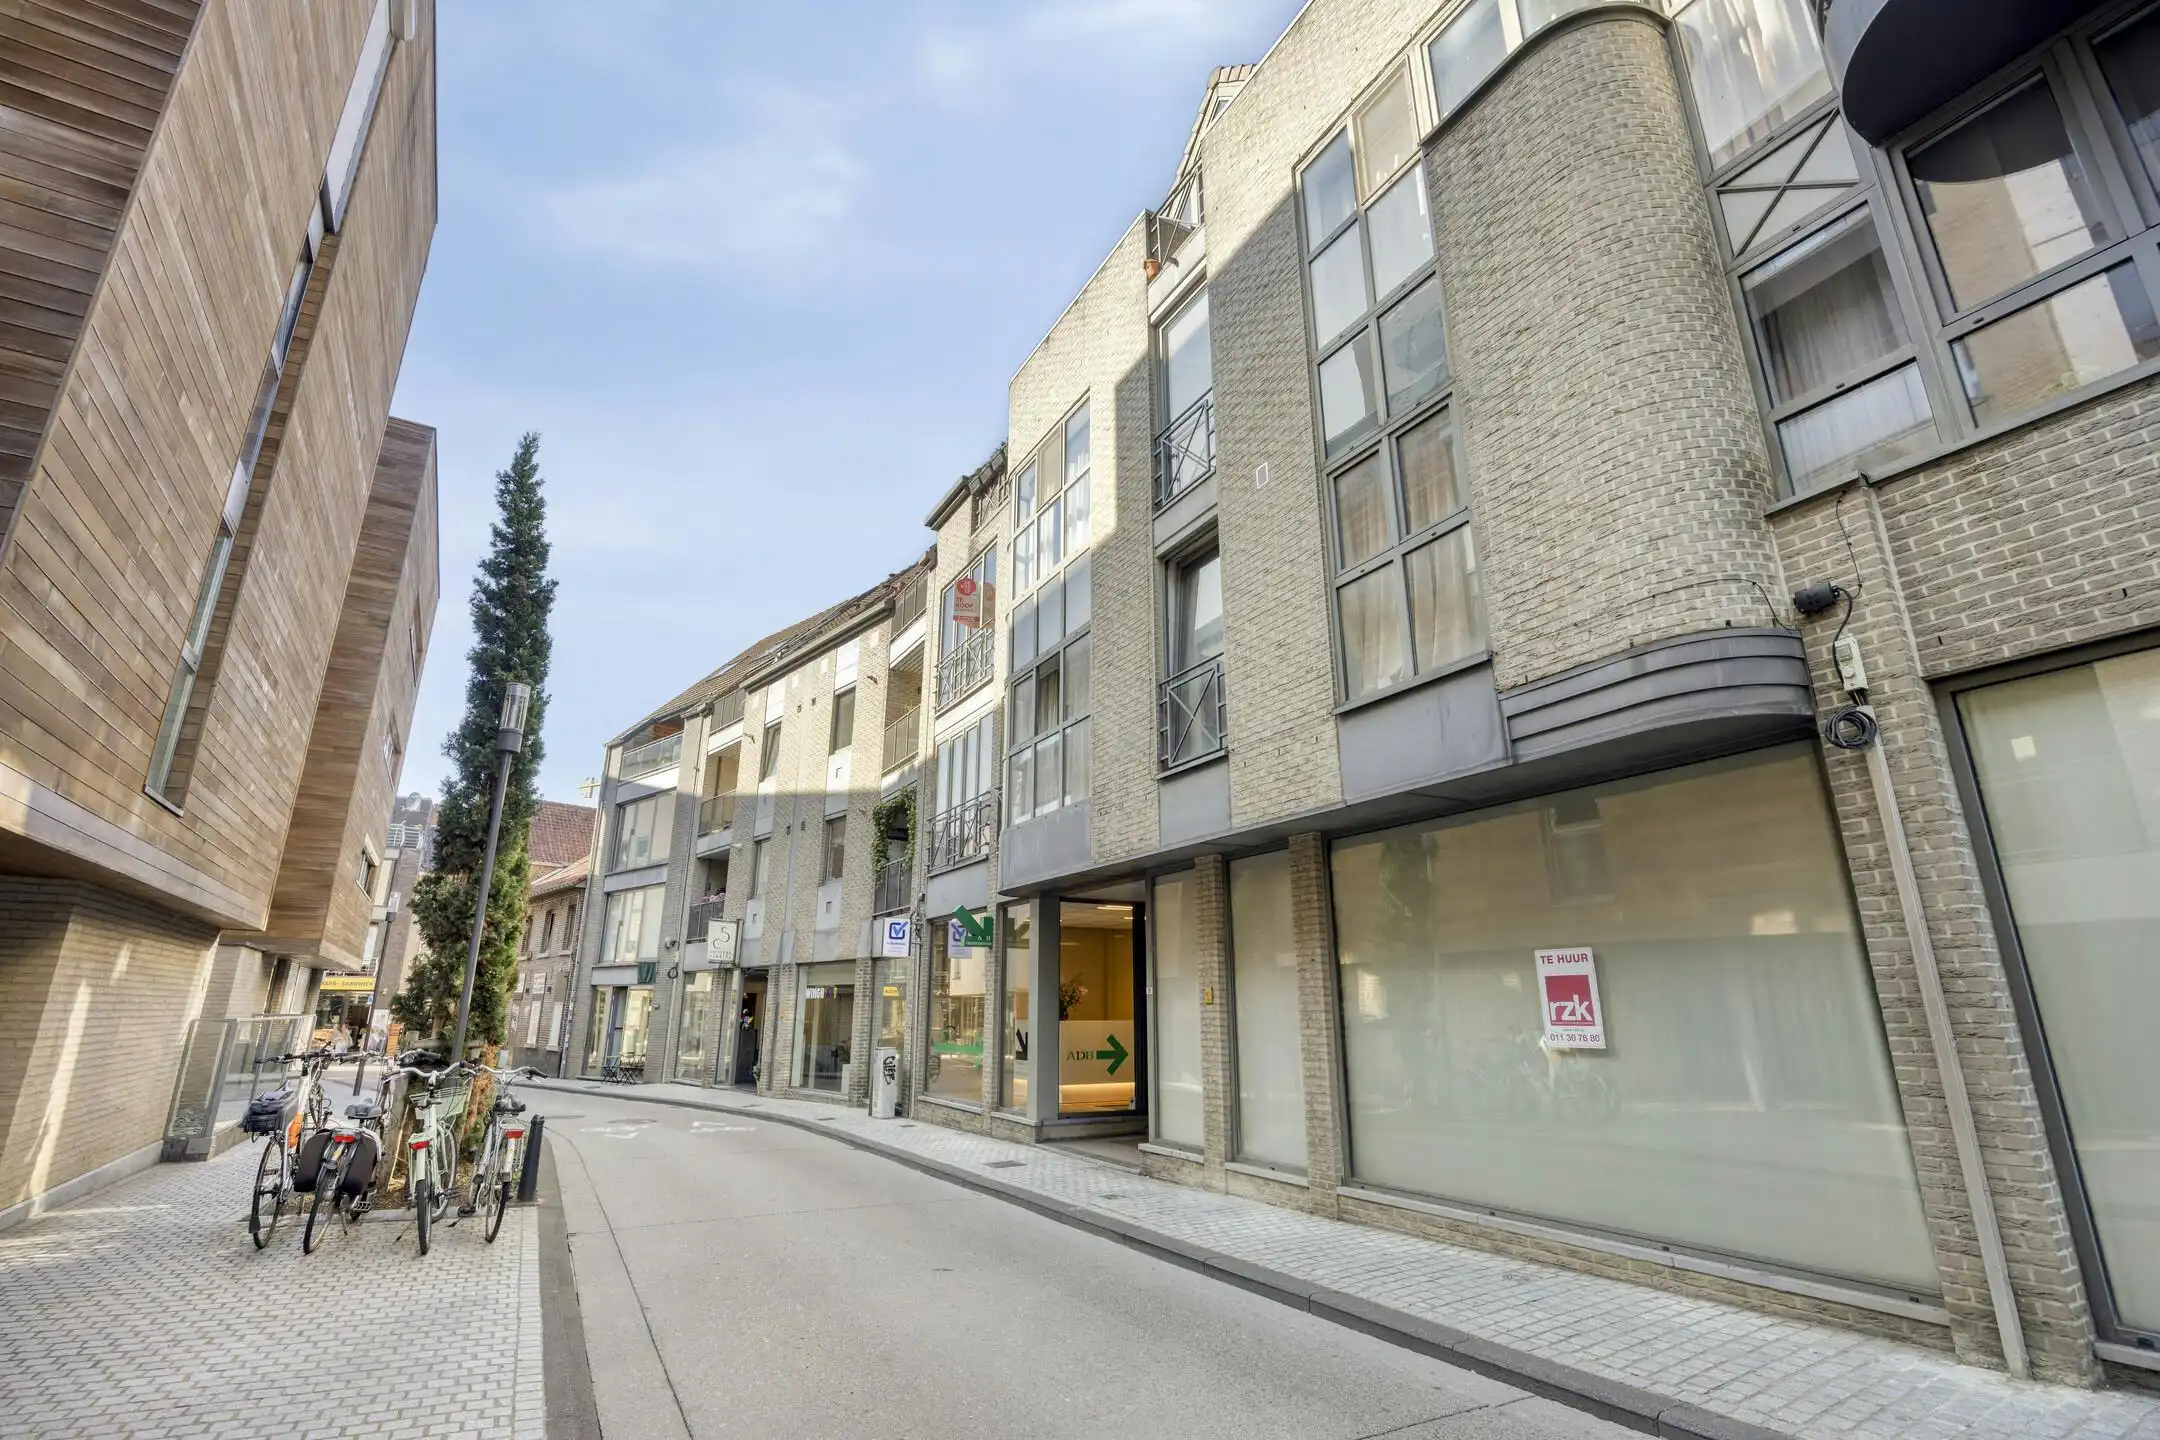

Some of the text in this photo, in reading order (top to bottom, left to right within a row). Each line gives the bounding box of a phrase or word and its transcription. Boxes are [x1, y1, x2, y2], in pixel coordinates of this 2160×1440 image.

[1540, 953, 1589, 965] TE HUUR
[1549, 994, 1593, 1021] rzk
[1550, 1033, 1564, 1042] 011
[1566, 1033, 1577, 1042] 30
[1589, 1034, 1600, 1043] 80
[1066, 1050, 1094, 1061] ADB
